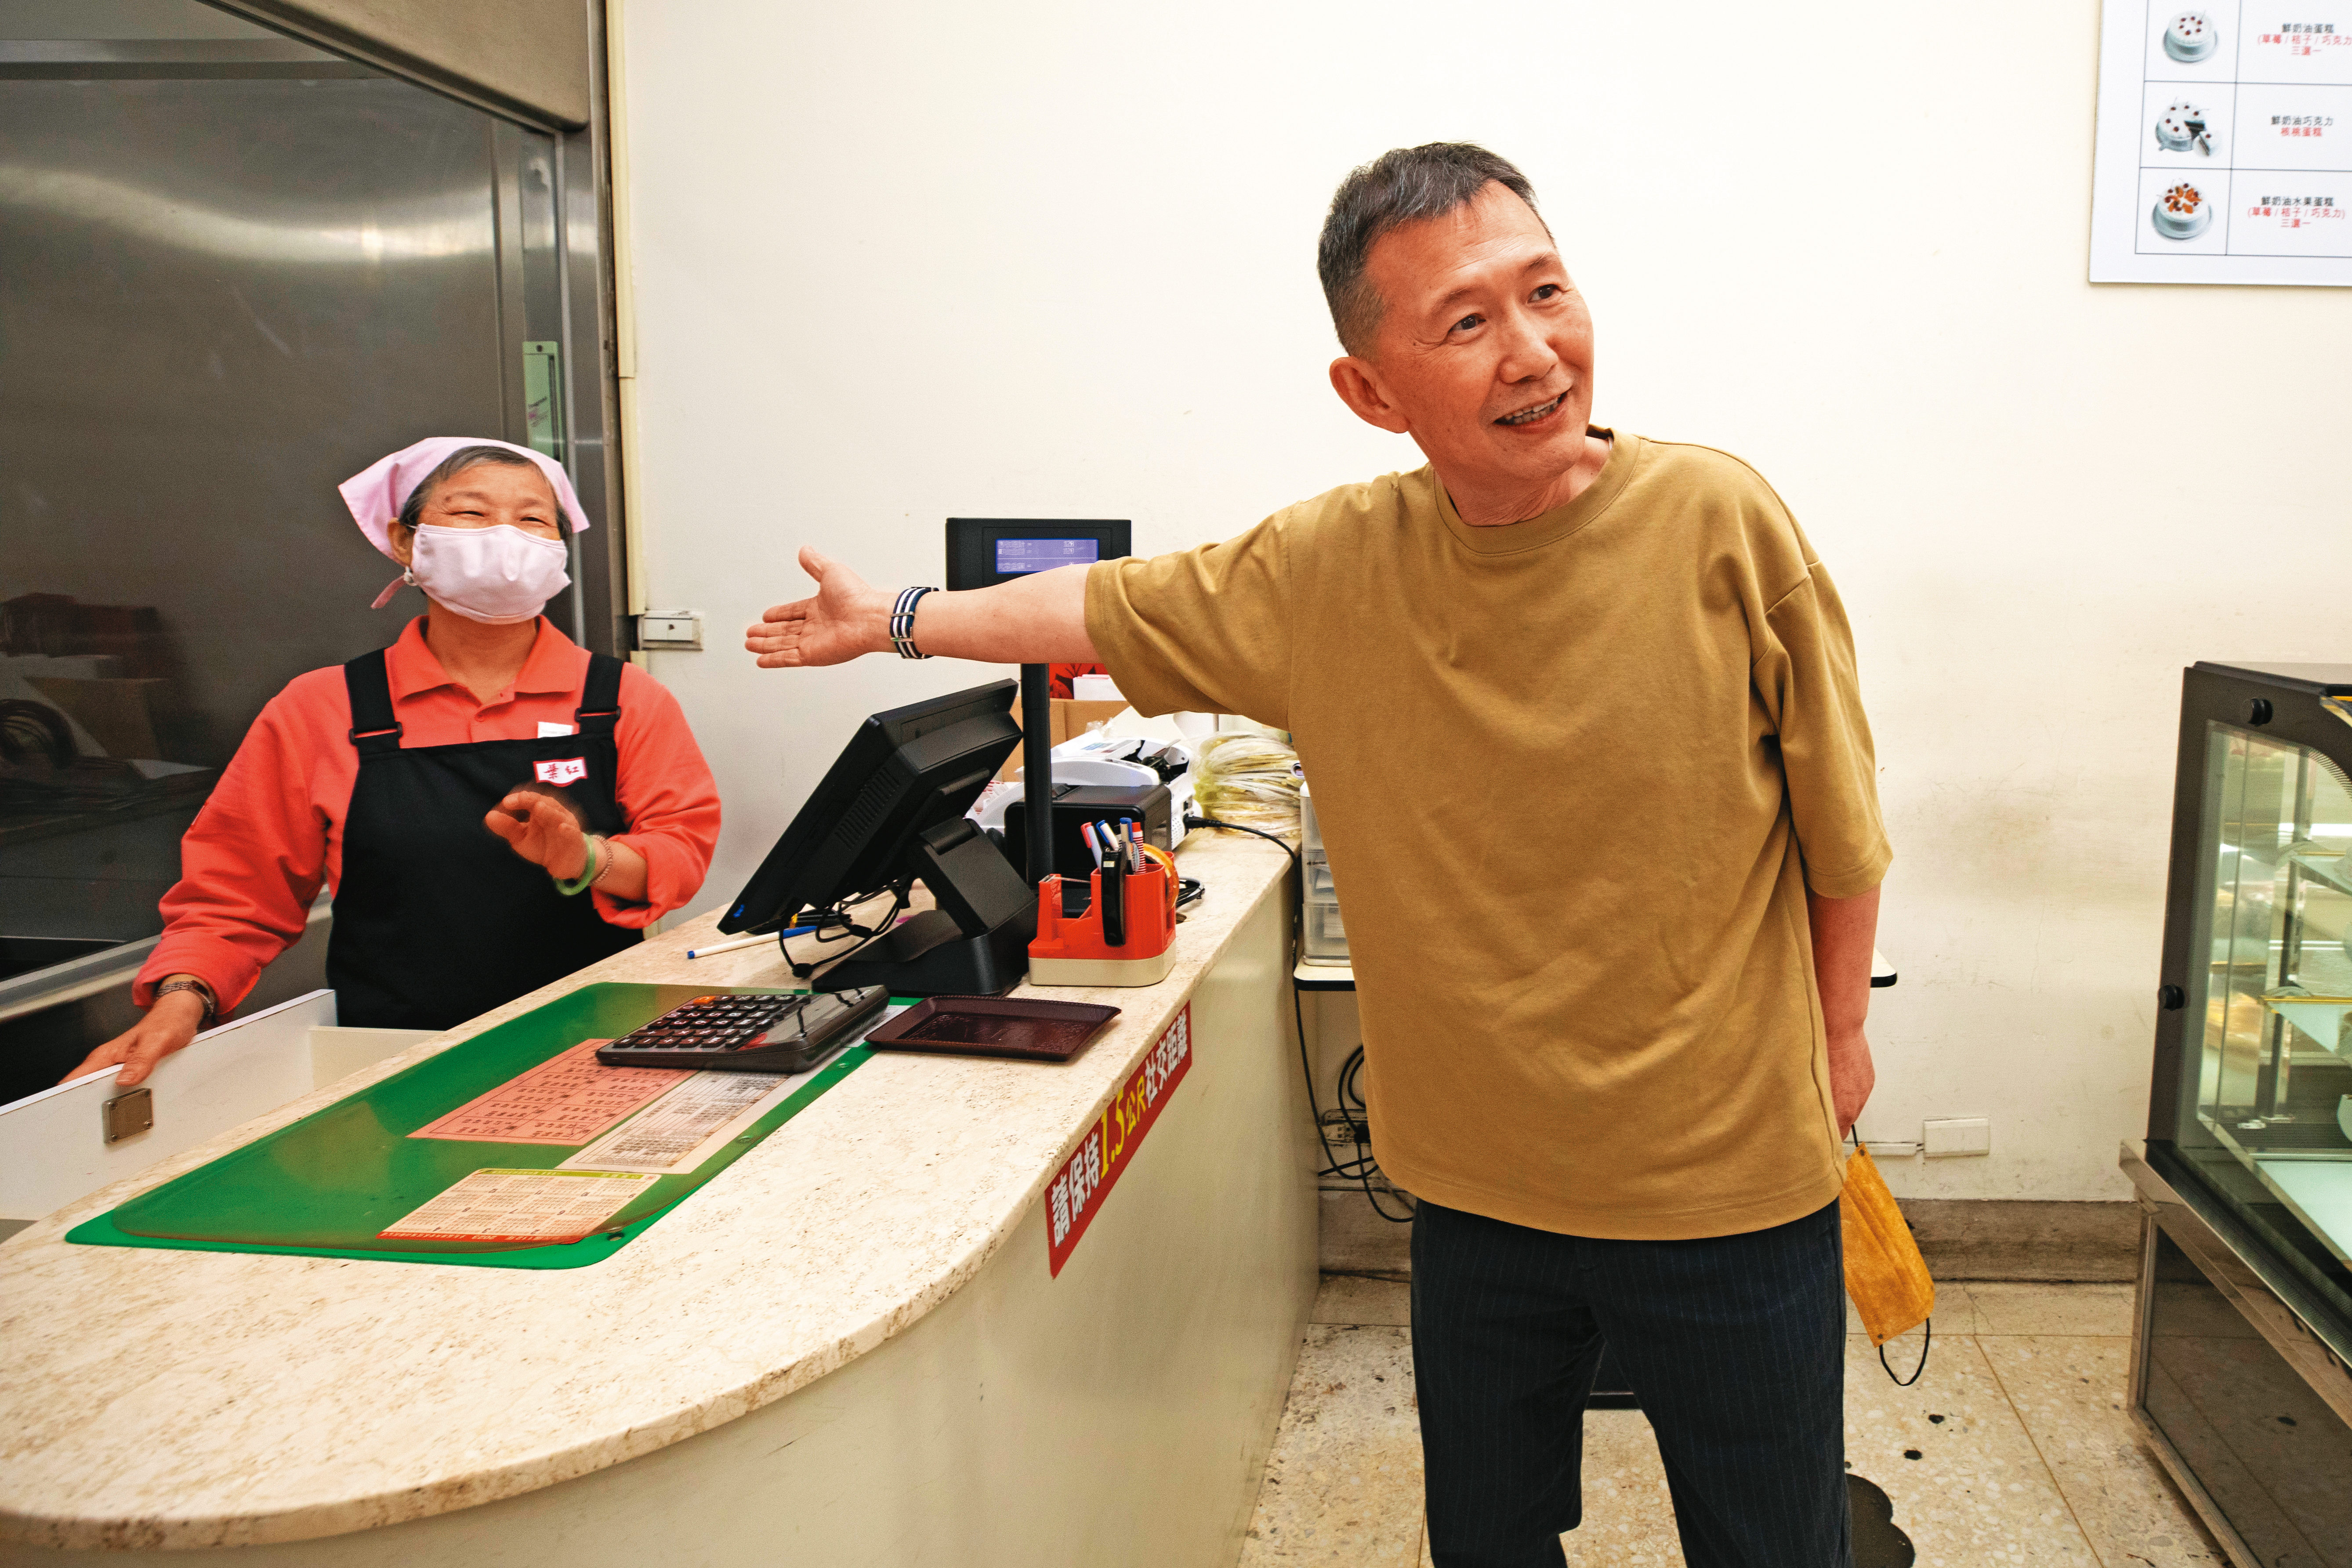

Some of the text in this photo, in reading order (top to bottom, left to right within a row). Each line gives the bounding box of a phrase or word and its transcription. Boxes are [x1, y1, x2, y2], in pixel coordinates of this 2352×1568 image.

[2282, 23, 2334, 33] 鮮奶油蛋糕
[2272, 116, 2333, 126] 鮮奶油巧克力
[2261, 196, 2334, 206] 鮮奶油水果蛋糕
